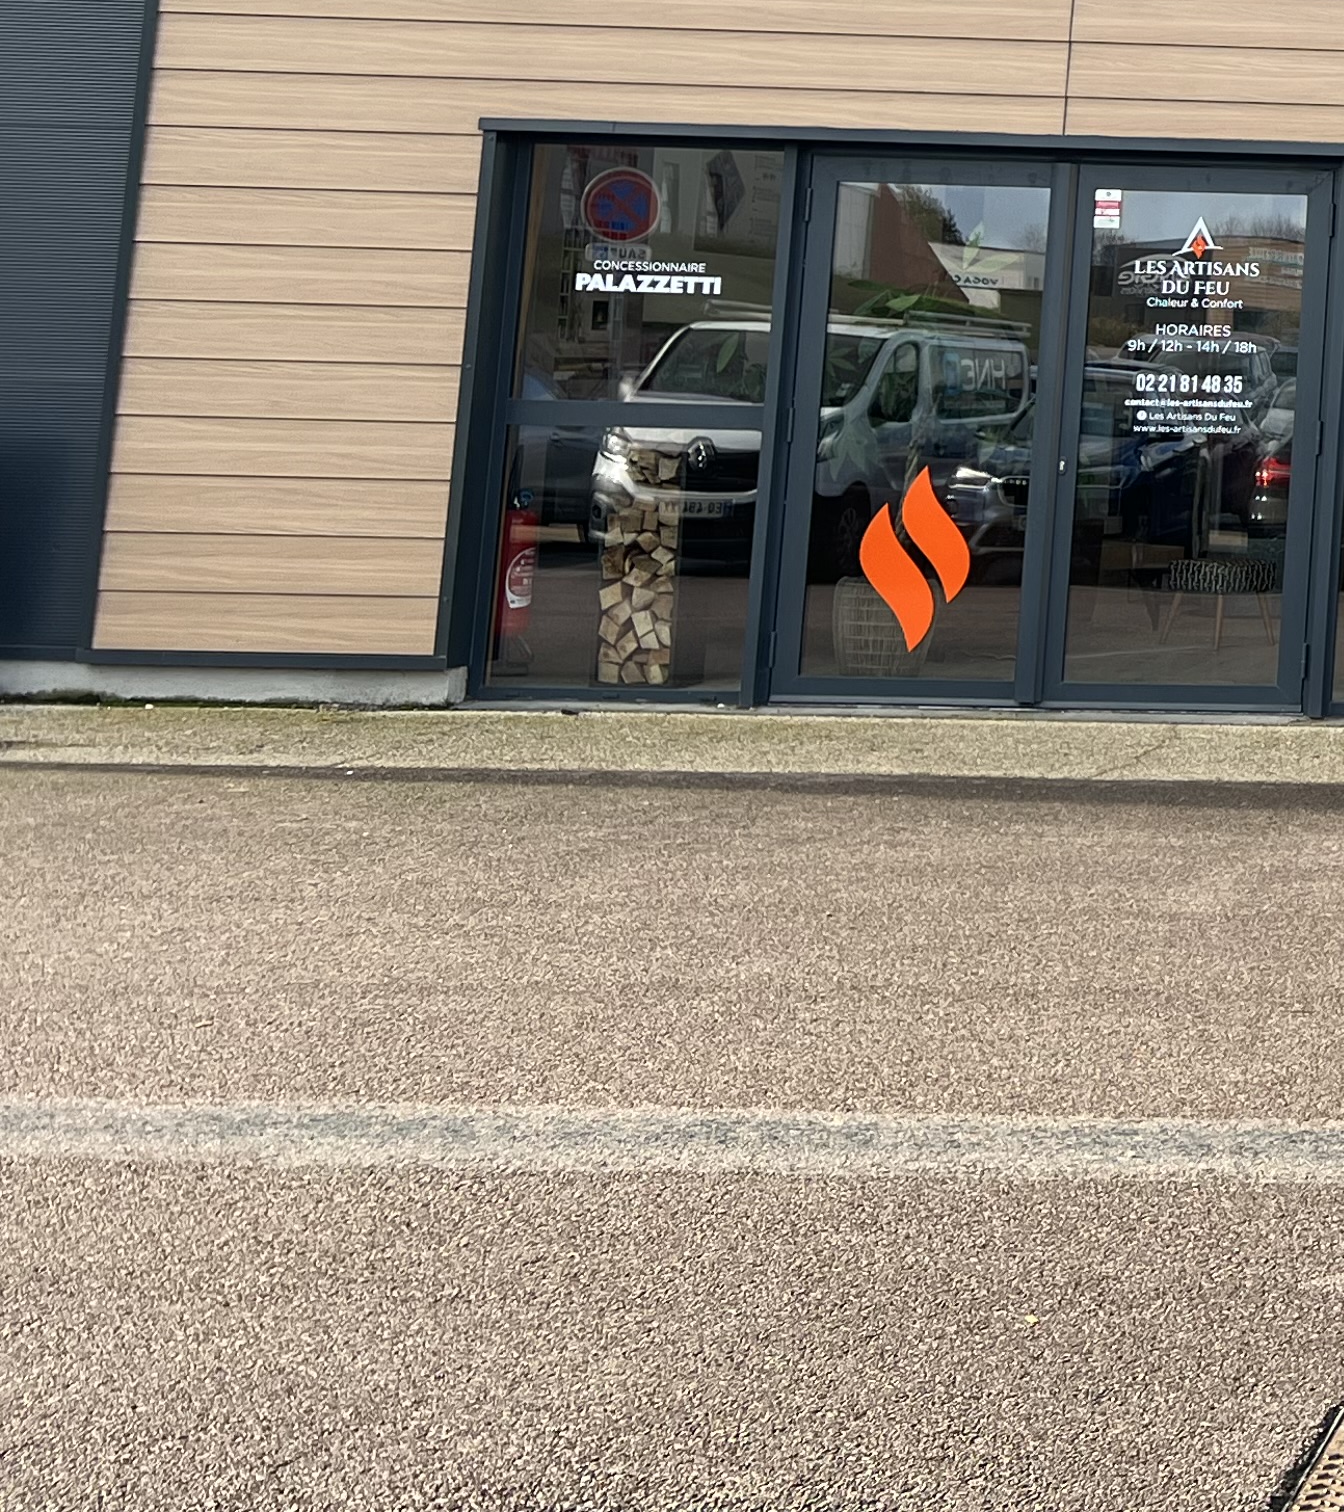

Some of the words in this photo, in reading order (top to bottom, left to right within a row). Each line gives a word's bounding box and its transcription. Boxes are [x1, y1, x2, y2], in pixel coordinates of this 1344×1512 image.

[594, 260, 707, 273] CONCESSIONNAIRE
[1134, 260, 1167, 275] LES
[1170, 260, 1260, 278] ARTISANS
[575, 272, 722, 295] PALAZZETTI
[1161, 280, 1190, 294] DU
[1193, 281, 1230, 296] FEU
[1146, 297, 1188, 308] Chaleur
[1190, 298, 1199, 308] &
[1201, 298, 1243, 309] Confort
[1155, 323, 1232, 337] HORAIRES
[1127, 339, 1146, 352] 9h
[1160, 339, 1182, 352] 12h
[1196, 340, 1219, 353] 14h
[1234, 341, 1257, 354] 18h
[1136, 373, 1155, 392] 02
[1158, 373, 1176, 393] 21
[1180, 374, 1198, 393] 81
[1223, 375, 1243, 394] 35
[1148, 412, 1164, 421] Les
[1166, 412, 1203, 421] Artisans
[1204, 412, 1218, 422] Du
[1219, 413, 1236, 422] Feu
